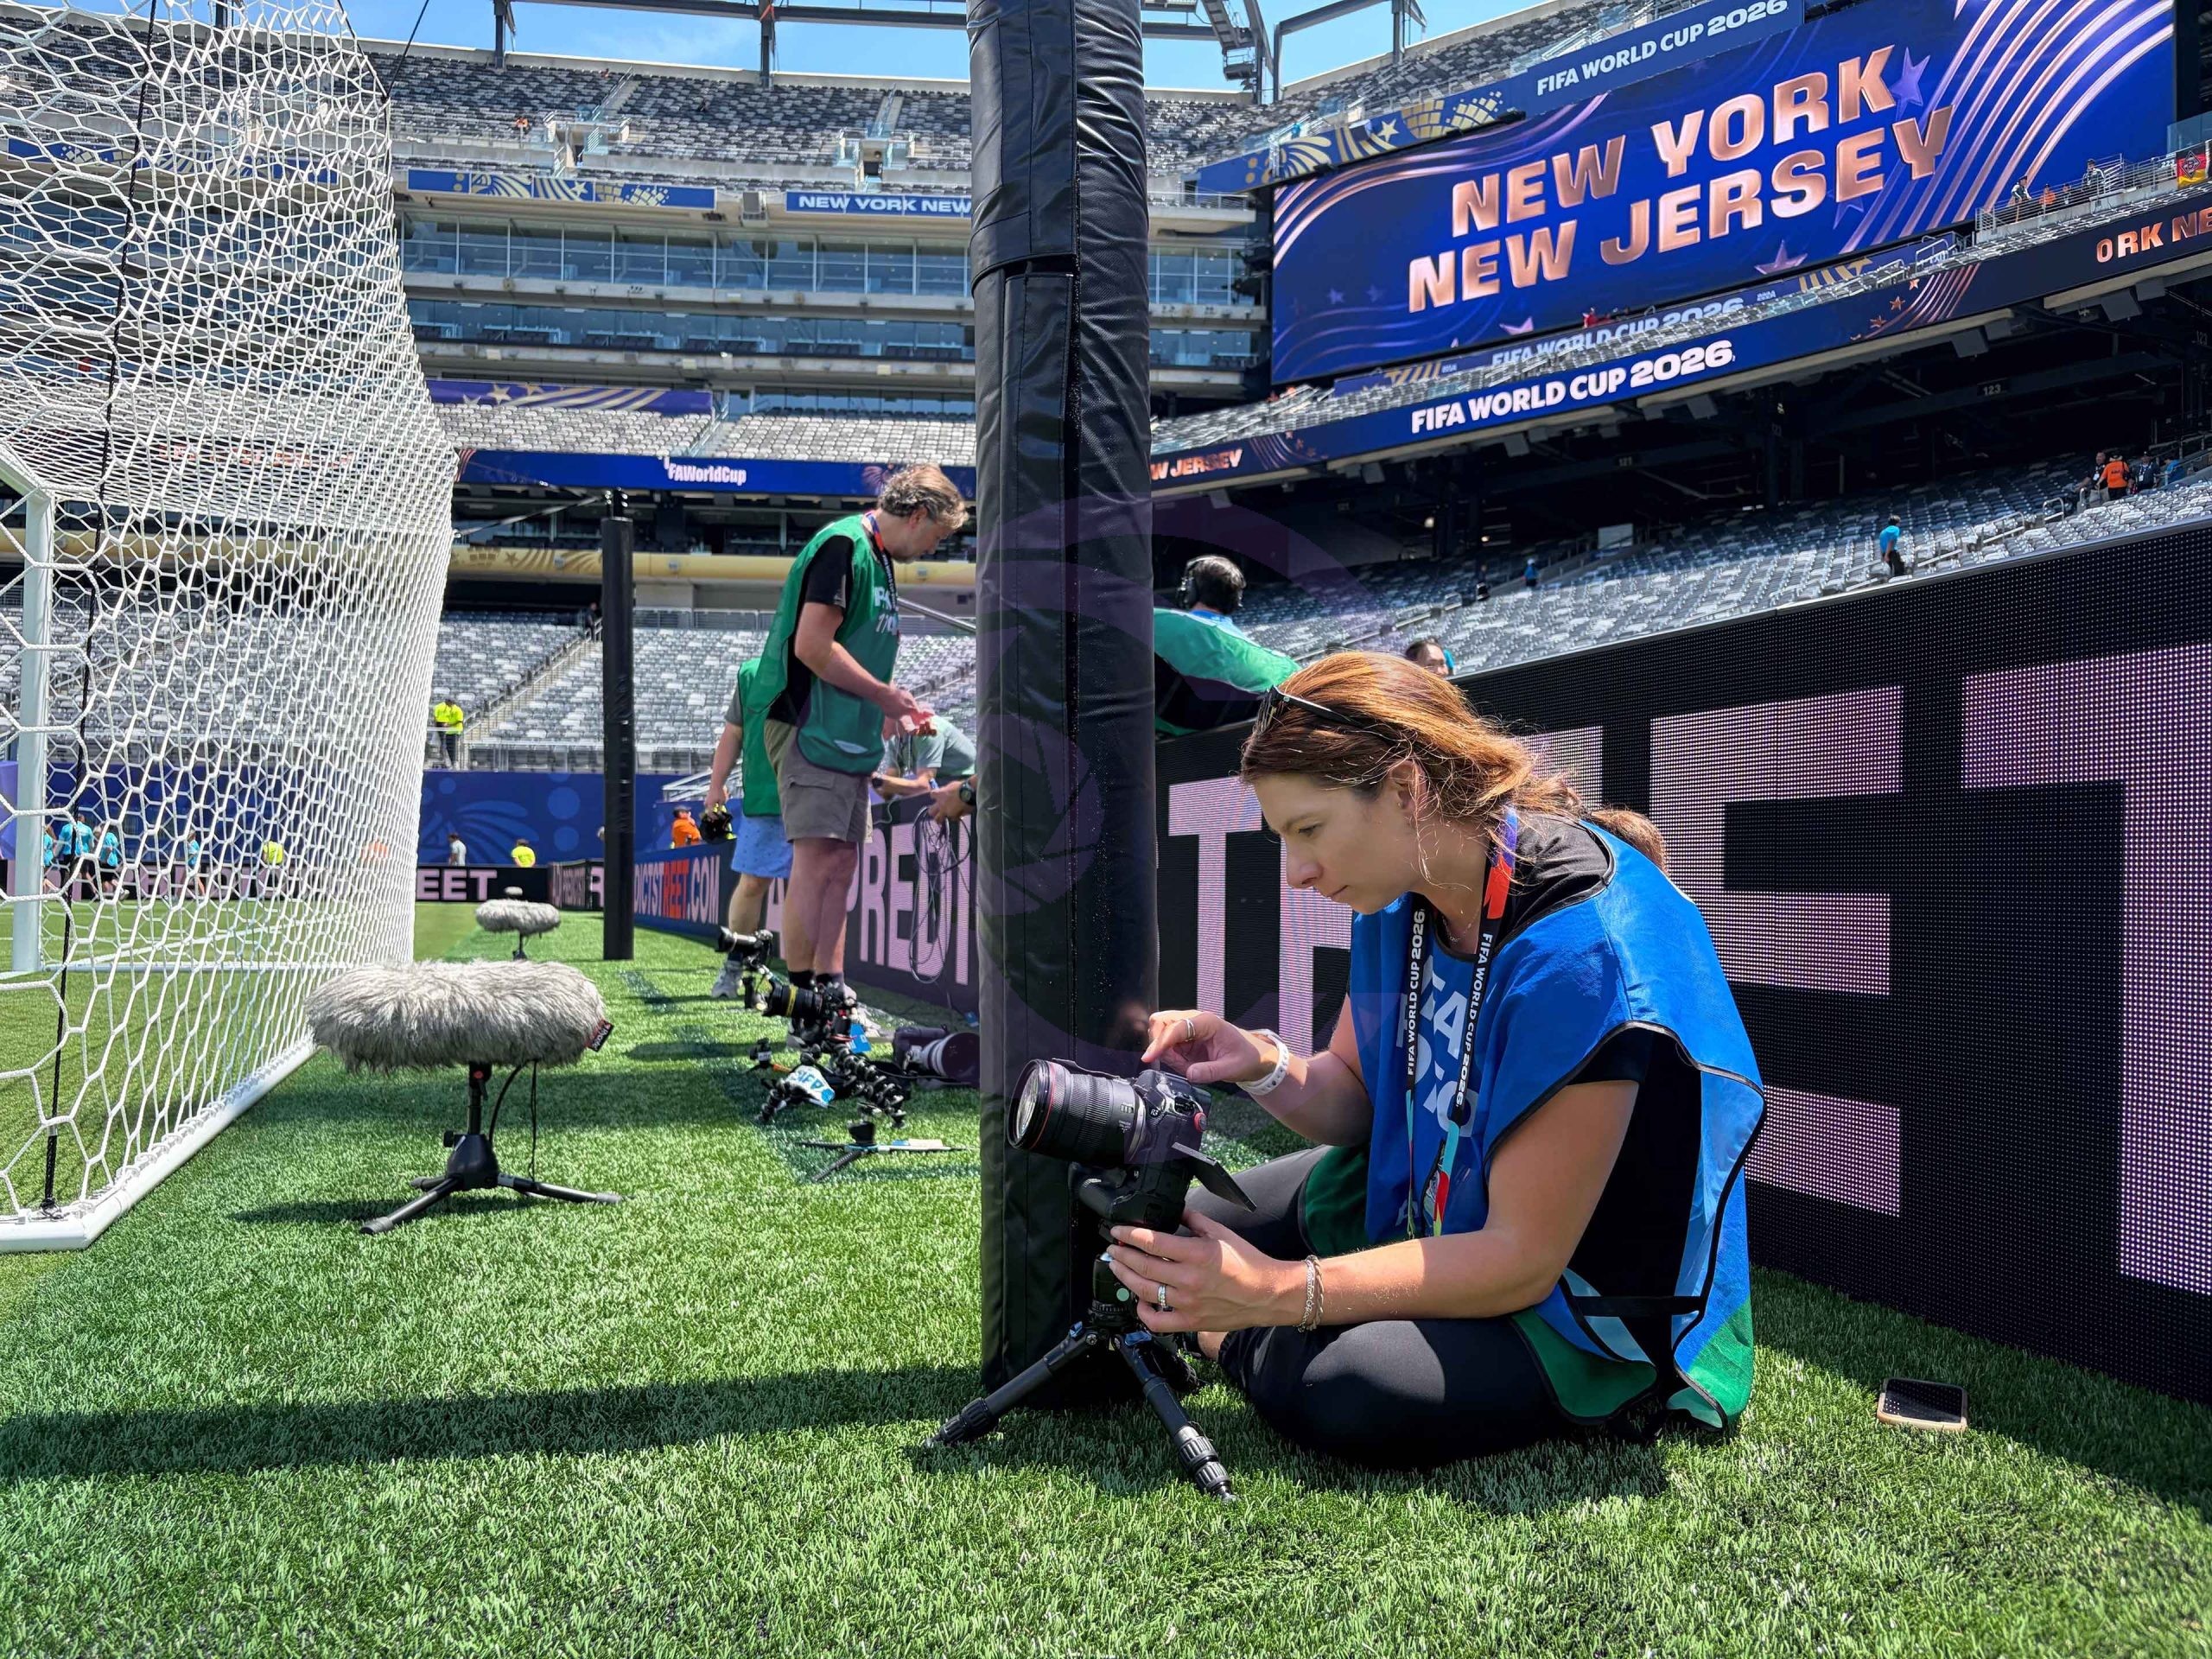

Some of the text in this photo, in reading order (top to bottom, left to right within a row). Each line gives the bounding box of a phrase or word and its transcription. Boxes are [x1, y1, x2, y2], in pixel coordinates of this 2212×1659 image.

[1537, 0, 1788, 96] FIFA WORLD CUP 2026
[1452, 44, 1897, 238] NEW YORK
[2162, 159, 2175, 168] 223
[798, 195, 971, 213] NEW YORK NEW
[1408, 105, 1954, 314] NEW JERSEY
[2096, 222, 2164, 263] ORK
[1491, 297, 1744, 365] FIFA WORLD CUP 2026
[1411, 340, 1733, 434] FIFA WORLD CUP 2026
[1983, 384, 2001, 395] 123
[1170, 448, 1243, 478] JERSEY
[1411, 910, 1425, 959] 2026
[1410, 961, 1420, 990] CUP
[1408, 992, 1418, 1043] WORLD
[1456, 932, 1493, 1106] FIFA WORLD CUP 2026
